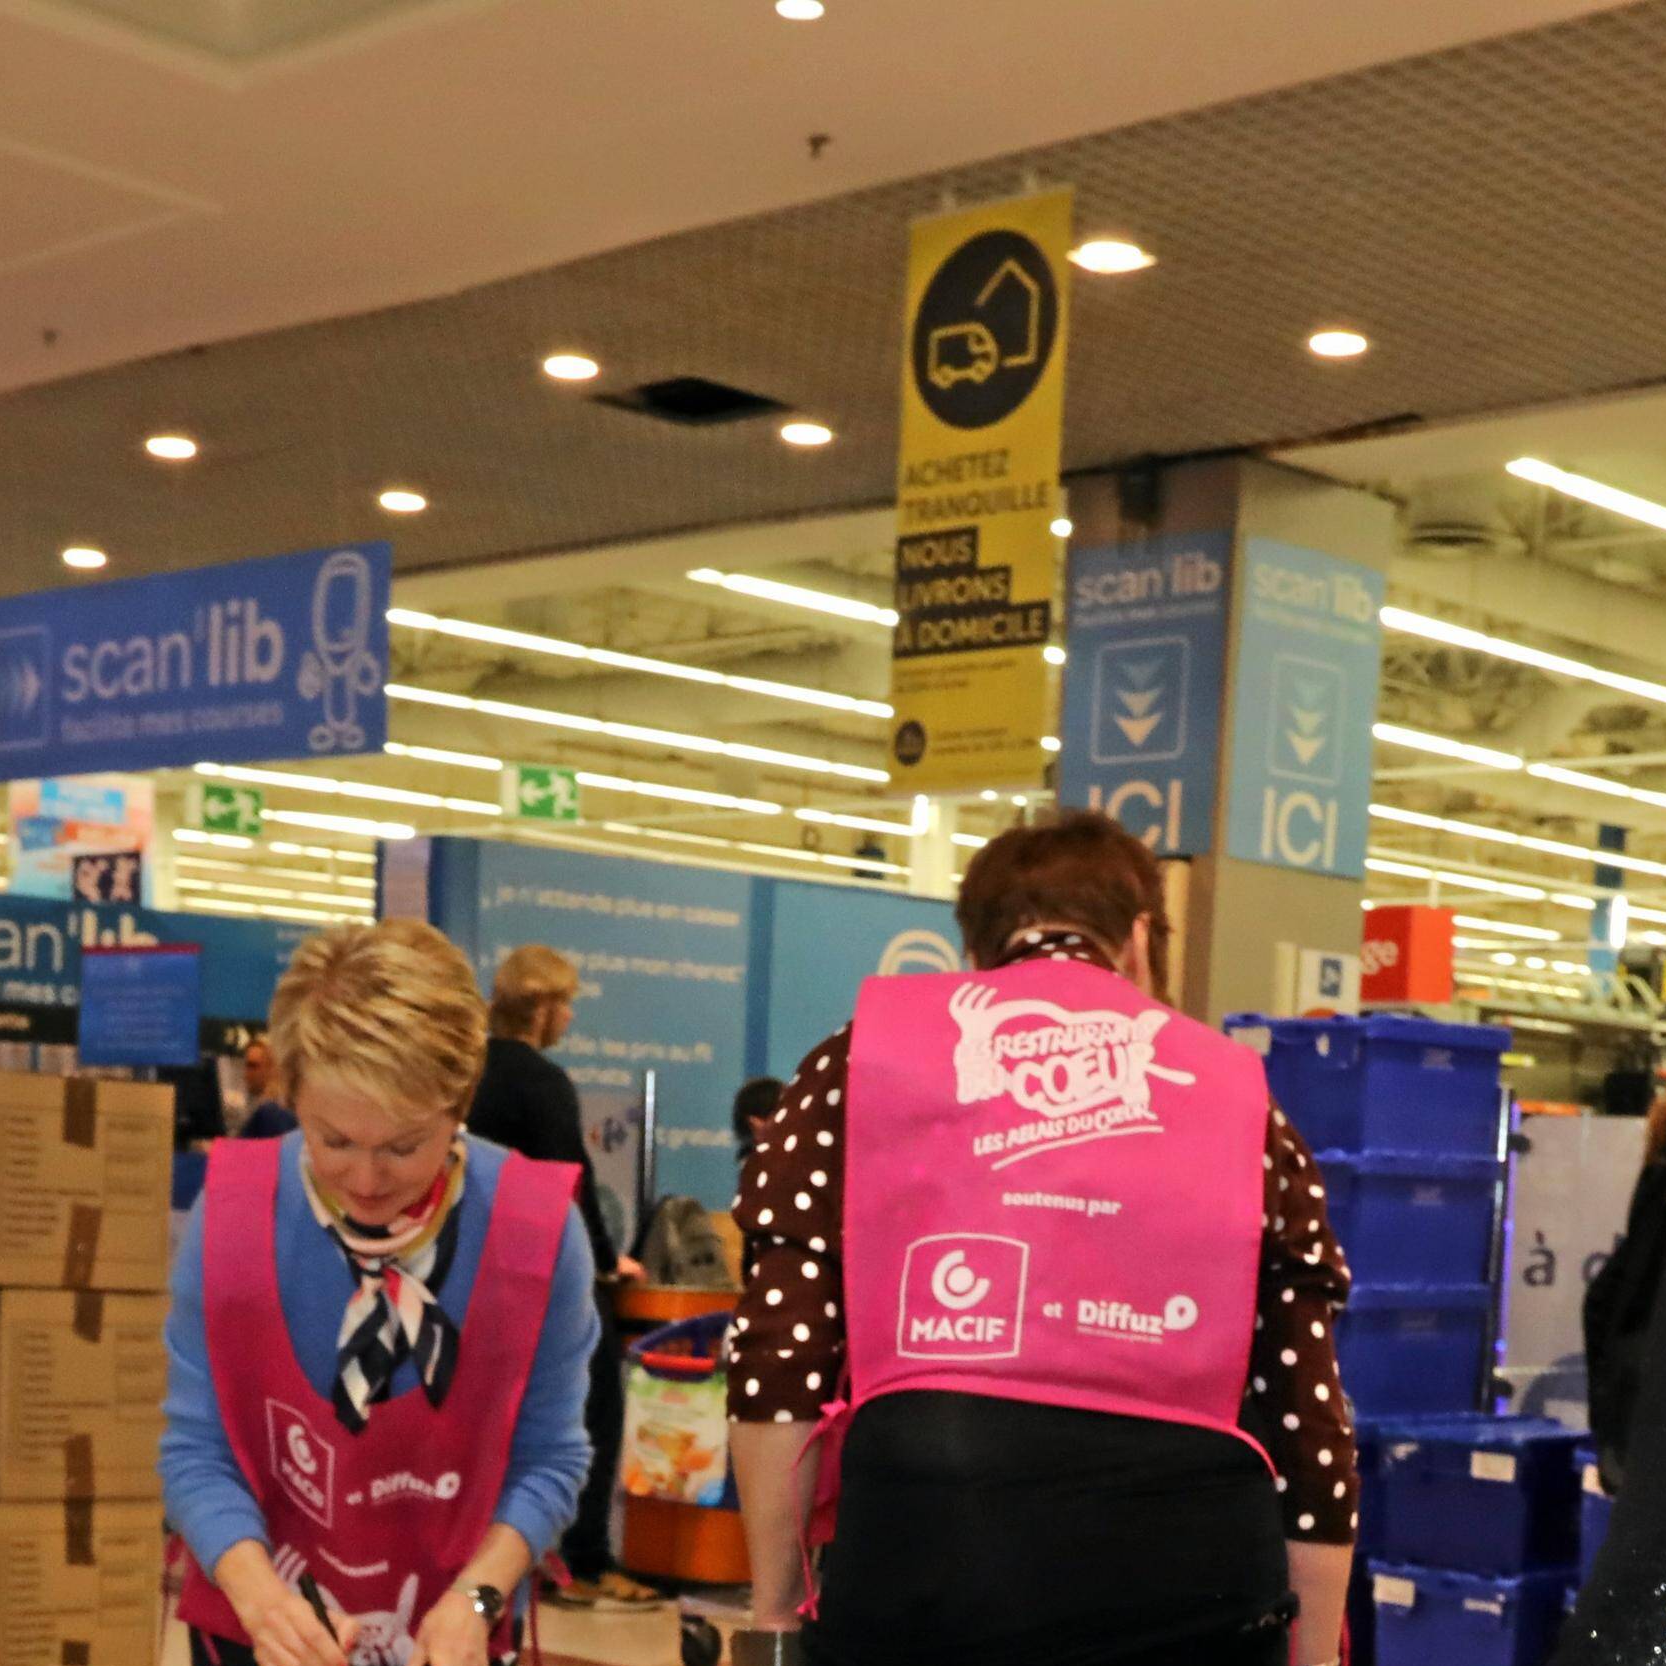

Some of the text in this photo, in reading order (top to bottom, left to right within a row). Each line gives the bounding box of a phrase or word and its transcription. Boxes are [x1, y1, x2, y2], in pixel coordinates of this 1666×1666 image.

[902, 536, 973, 568] NOUS
[918, 606, 1046, 650] DOMICILE
[1261, 786, 1338, 870] ICI
[1002, 1191, 1123, 1218] soutenus par
[910, 1316, 1007, 1343] MACIF
[1042, 1301, 1063, 1319] et
[1077, 1299, 1165, 1336] Diffuz
